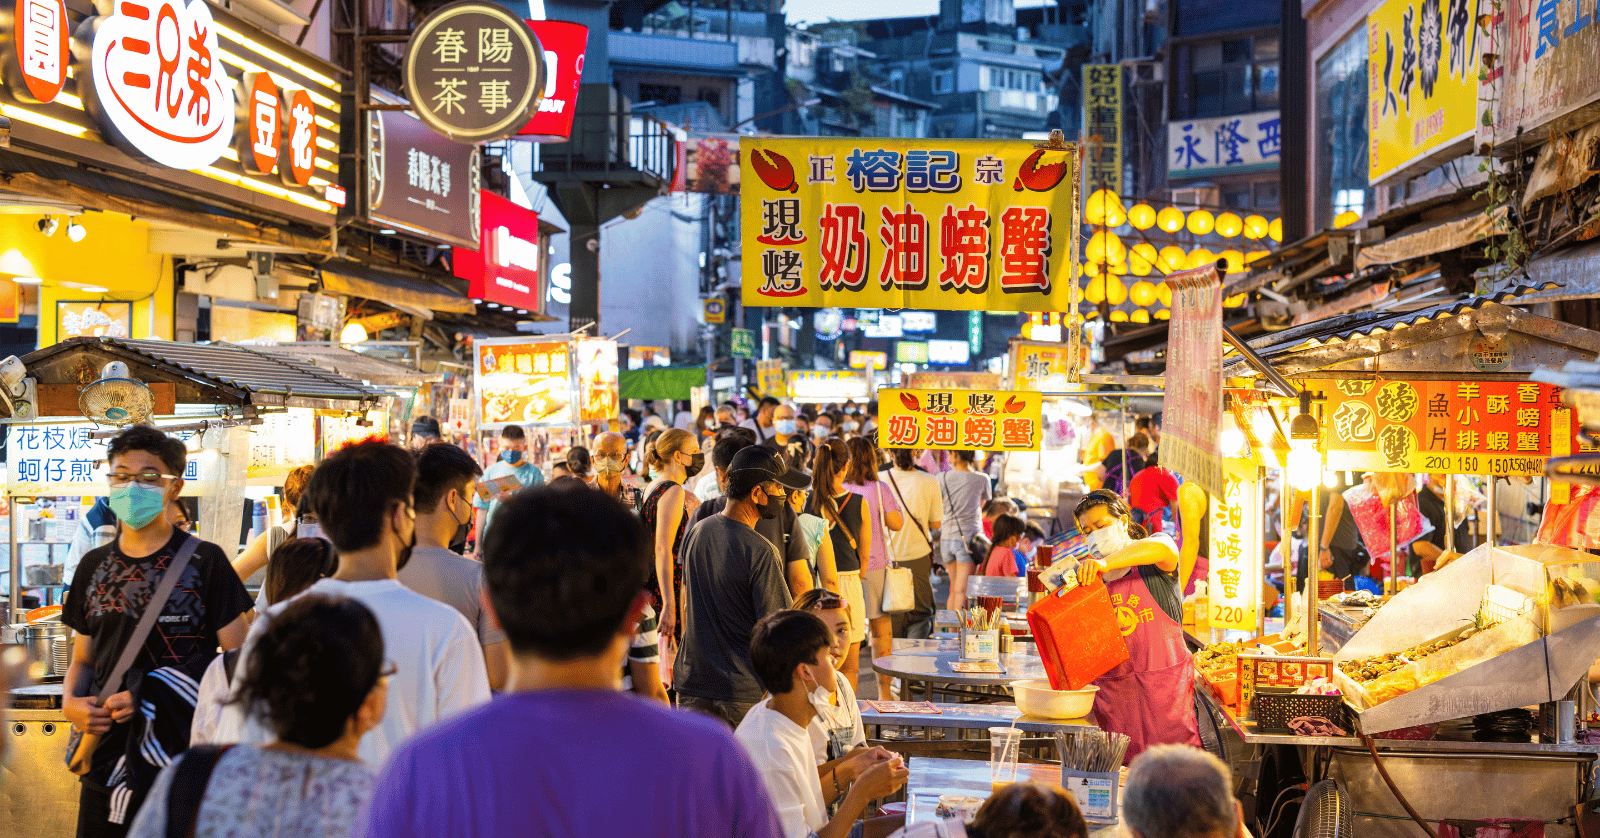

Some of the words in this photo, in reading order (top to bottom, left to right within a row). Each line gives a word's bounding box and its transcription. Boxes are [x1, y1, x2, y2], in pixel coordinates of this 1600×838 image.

[432, 27, 513, 63] 春陽
[120, 1, 212, 127] 三兄弟
[254, 89, 313, 170] 豆花
[432, 77, 512, 115] 茶事
[408, 147, 451, 198] 春陽茶事
[808, 155, 836, 185] 正
[847, 148, 962, 192] 榕記
[975, 155, 1005, 185] 宗
[761, 198, 804, 293] 現烤
[818, 202, 1053, 292] 奶油螃蟹
[926, 392, 996, 414] 現烤
[1375, 382, 1417, 469] 螃蟹
[1428, 393, 1451, 451] 魚片
[1456, 381, 1481, 450] 羊小排
[1485, 394, 1511, 452] 酥蝦
[1516, 382, 1541, 452] 香螃蟹
[887, 415, 1034, 448] 奶油螃蟹
[18, 457, 94, 482] 蚵仔煎
[1425, 456, 1451, 470] 200
[1458, 457, 1479, 472] 150
[1487, 458, 1508, 474] 150
[158, 615, 181, 623] WORK
[1214, 605, 1243, 624] 220
